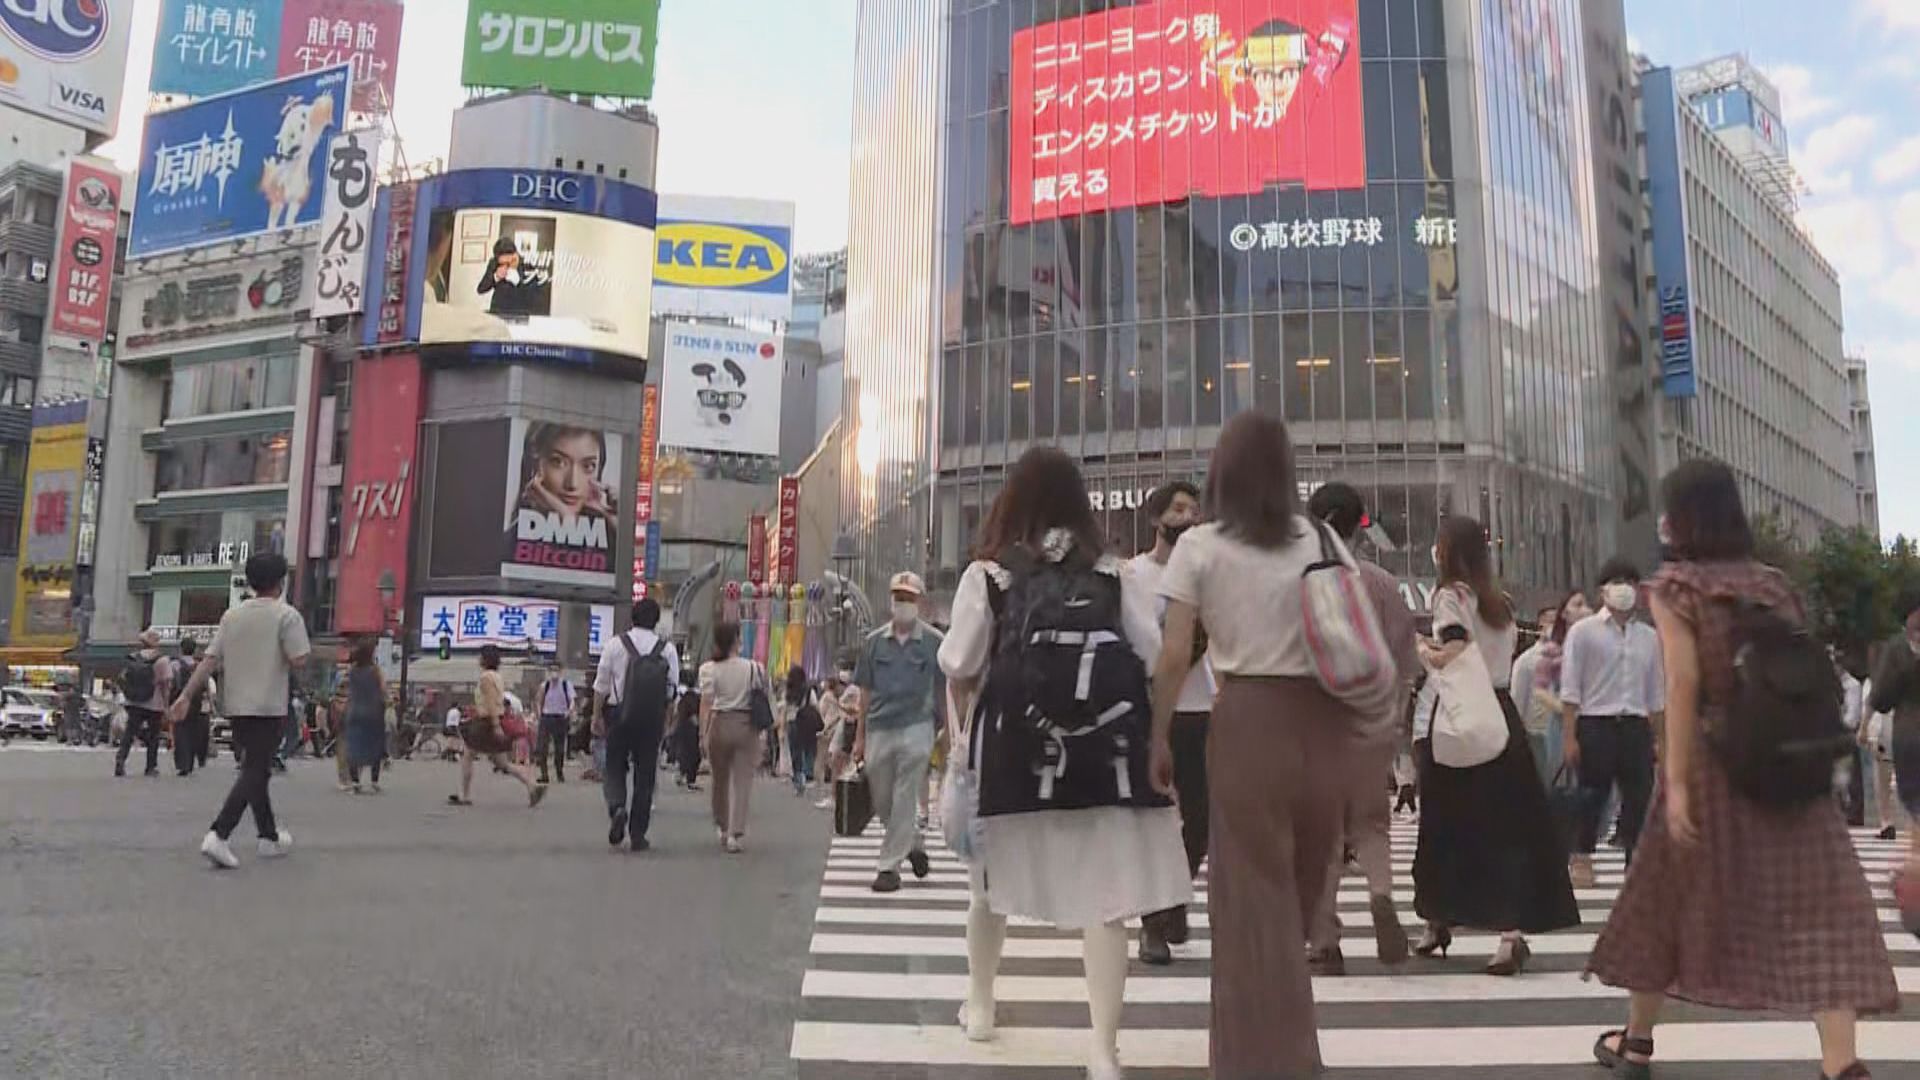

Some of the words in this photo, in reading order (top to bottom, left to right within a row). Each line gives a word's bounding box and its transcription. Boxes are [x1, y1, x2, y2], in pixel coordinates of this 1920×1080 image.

[479, 12, 645, 65] サロンパス
[1033, 14, 1220, 68] ニューヨーク発
[59, 84, 105, 113] VISA
[510, 174, 582, 203] DHC
[1033, 170, 1109, 205] 買える
[317, 134, 372, 308] もんじゃ
[725, 340, 758, 354] SUN
[517, 508, 608, 549] DMM
[515, 541, 607, 571] Bitcoin
